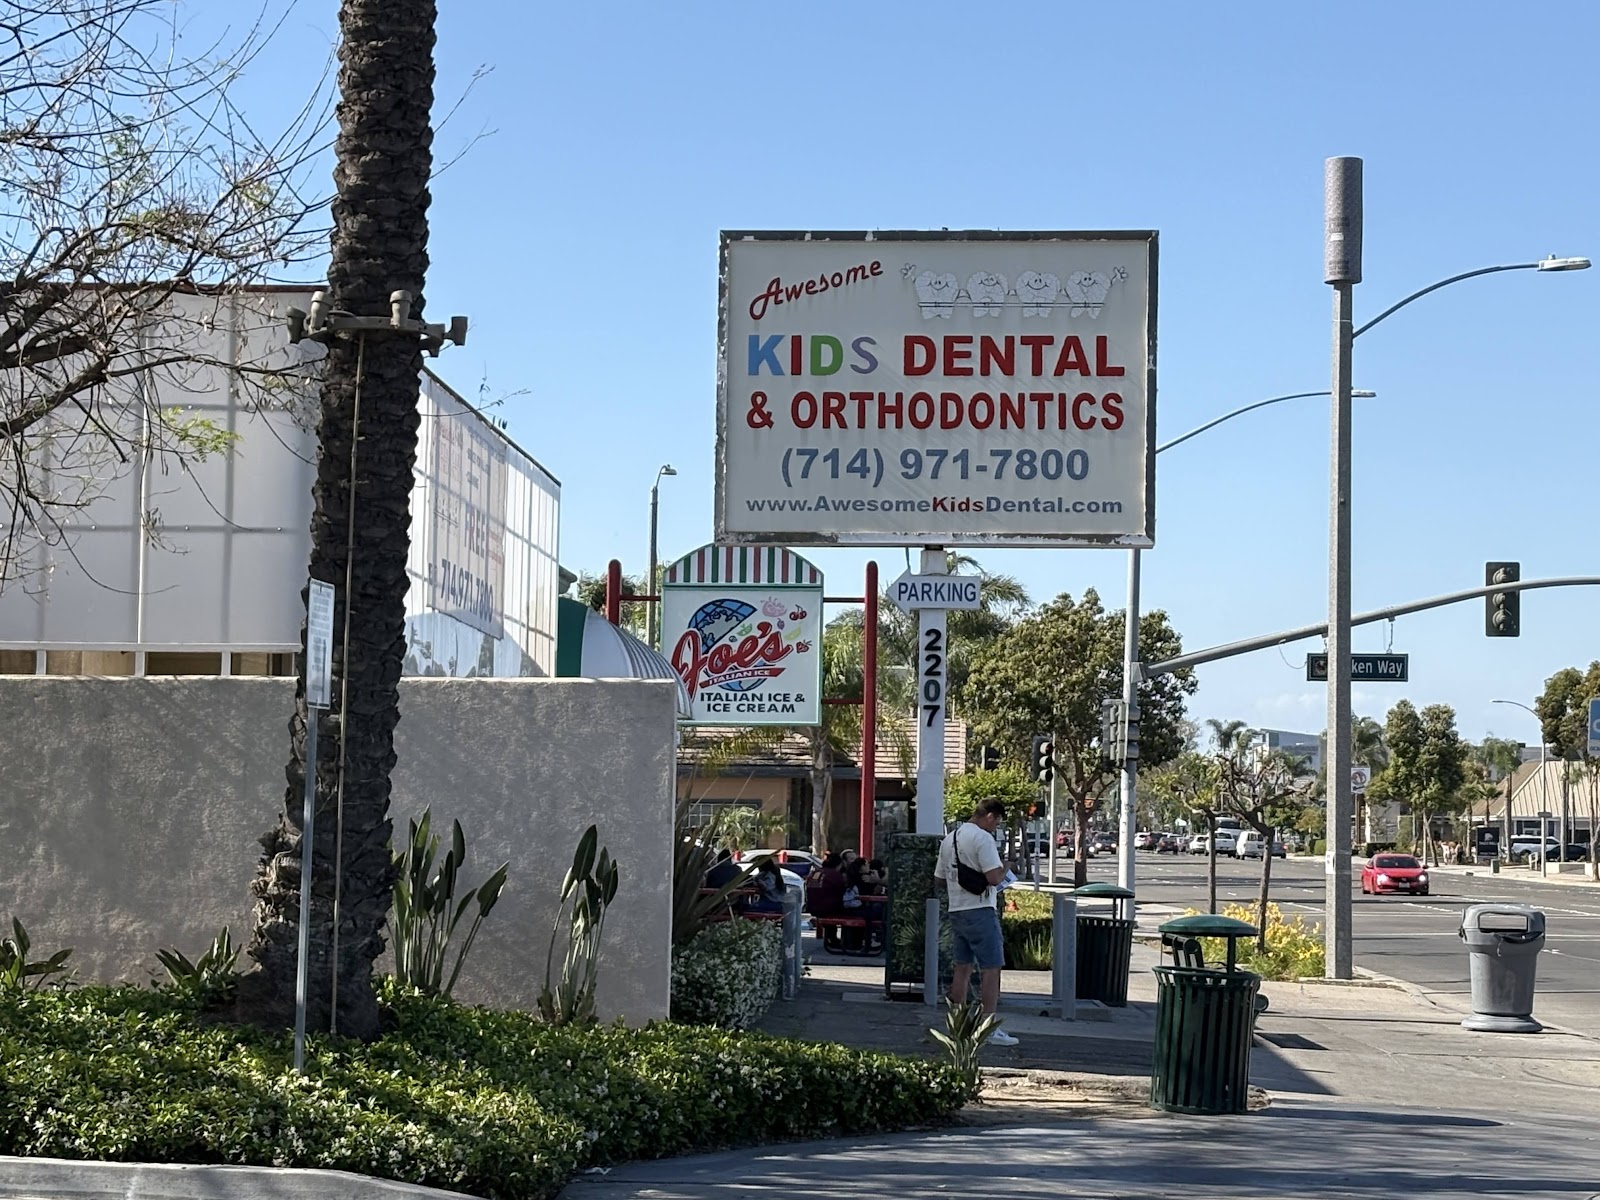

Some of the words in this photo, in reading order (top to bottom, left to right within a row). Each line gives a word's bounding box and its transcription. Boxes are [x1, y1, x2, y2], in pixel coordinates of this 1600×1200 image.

[749, 260, 884, 321] Awesome
[747, 335, 879, 377] KIDS
[903, 335, 1125, 377] DENTAL
[746, 391, 774, 430] &
[790, 391, 1125, 431] ORTHODONTICS
[781, 447, 885, 488] (714)
[900, 448, 1090, 481] 971-7800
[746, 496, 1123, 514] www.AwesomeKidsDental.com
[898, 582, 977, 602] PARKING
[671, 621, 794, 704] Joe's
[709, 671, 752, 685] ITALIAN
[754, 669, 771, 677] ICE
[1351, 659, 1373, 674] ken
[1378, 660, 1403, 677] Way
[923, 628, 942, 728] 2207
[700, 692, 763, 702] ITALIAN
[768, 692, 791, 702] ICE
[794, 693, 806, 703] &
[706, 703, 731, 713] ICE
[736, 703, 796, 713] CREAM
